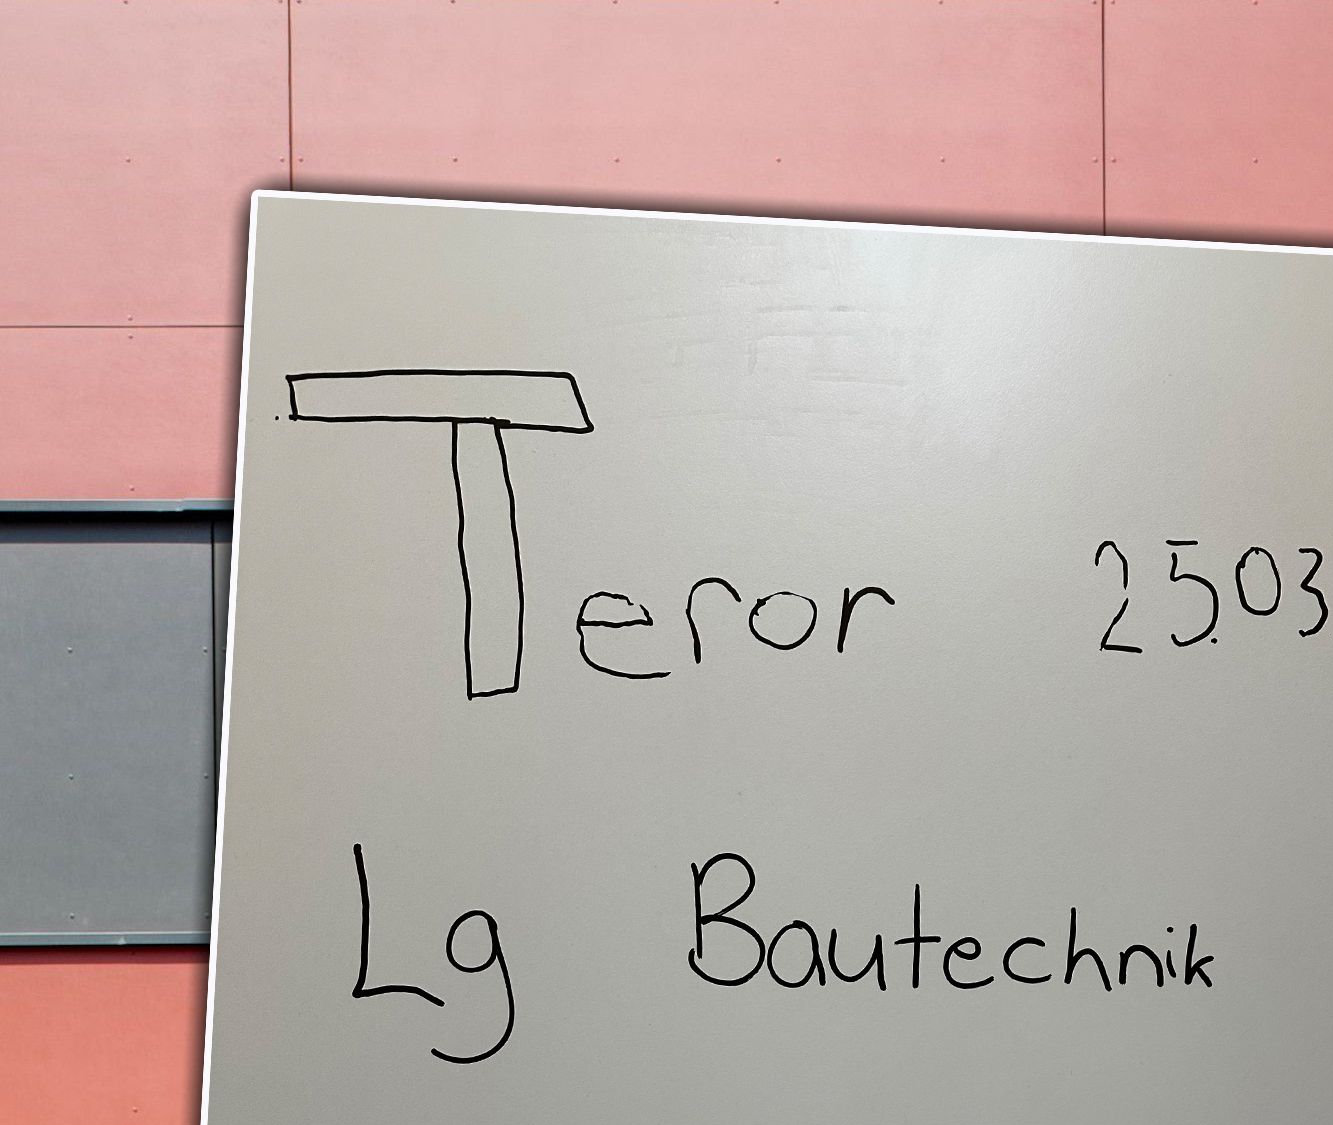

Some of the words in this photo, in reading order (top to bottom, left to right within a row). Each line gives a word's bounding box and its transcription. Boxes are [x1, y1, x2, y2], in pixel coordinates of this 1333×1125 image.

[284, 368, 896, 702] Teror
[351, 843, 516, 1064] Lg
[687, 852, 1215, 993] Bautechnik
